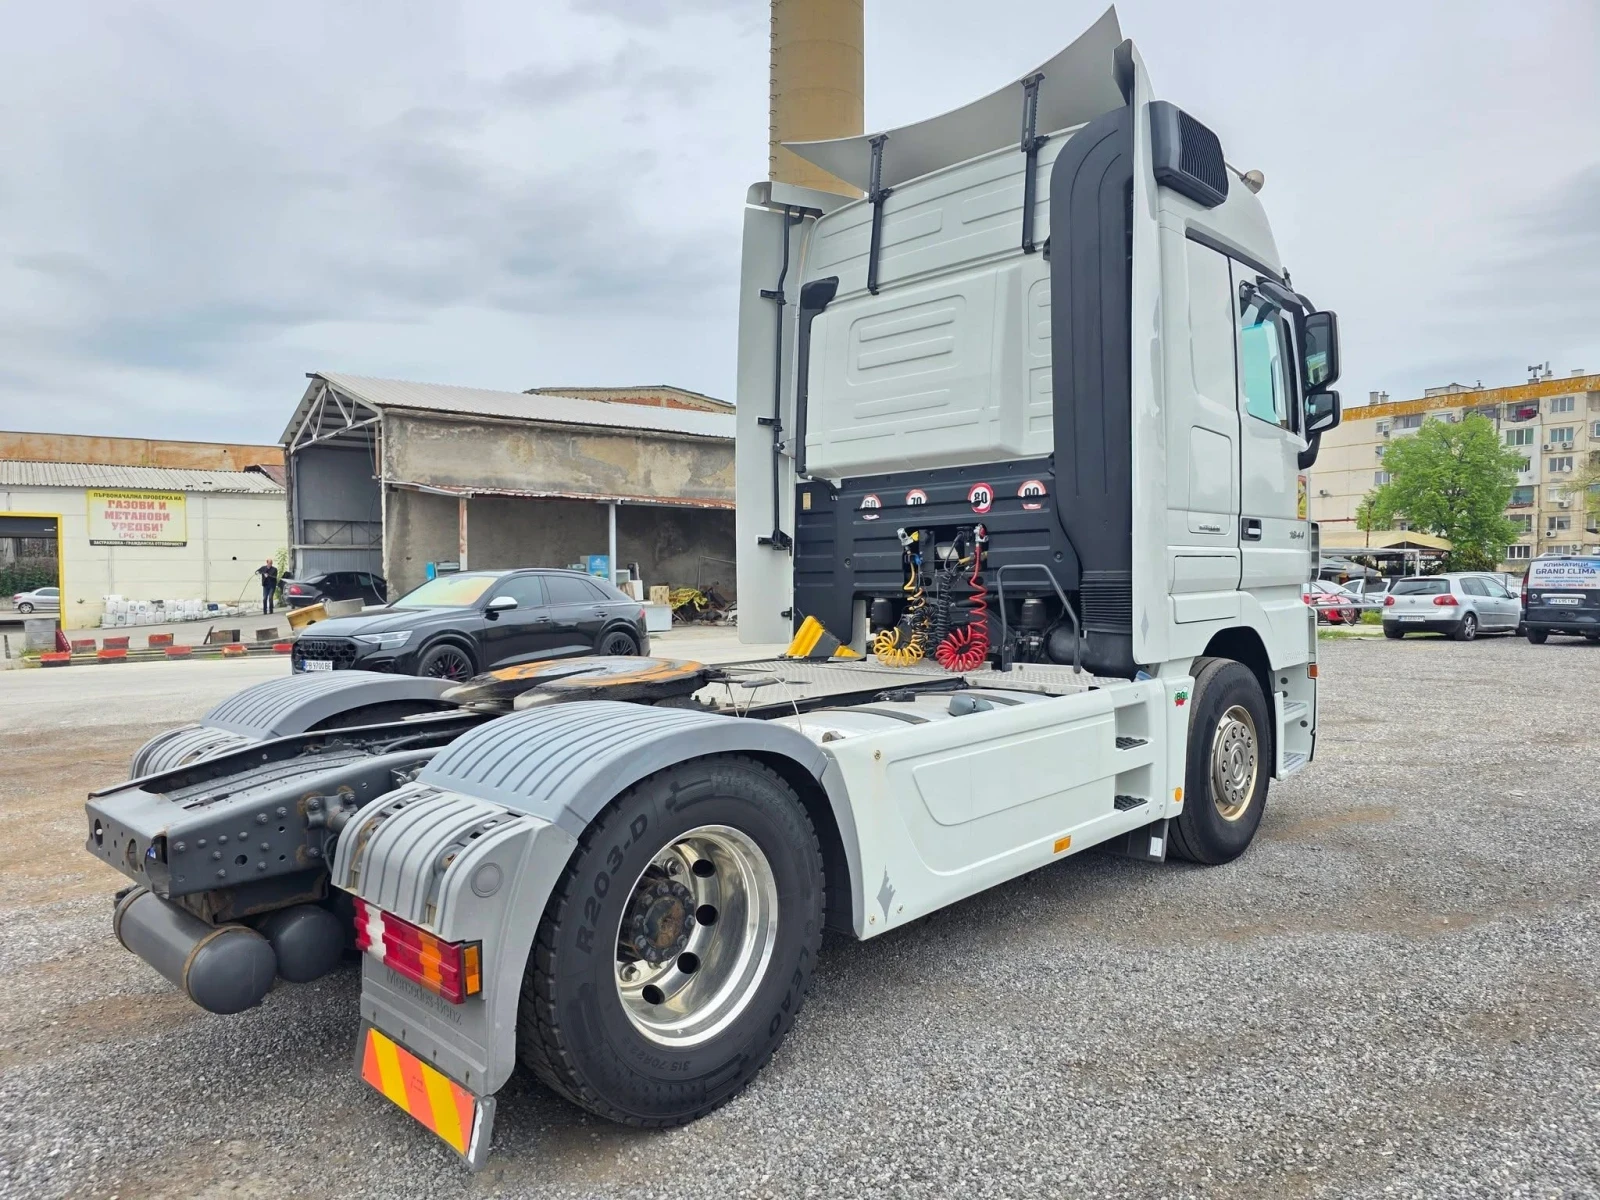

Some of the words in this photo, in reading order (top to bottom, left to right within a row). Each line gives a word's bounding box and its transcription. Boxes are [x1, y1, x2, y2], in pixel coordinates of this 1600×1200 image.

[974, 491, 987, 503] 80
[107, 500, 155, 510] ГАЗОВИ
[159, 501, 166, 510] И
[104, 511, 170, 521] МЕТАНОВИ
[111, 522, 163, 532] УРЕДБИ!
[575, 813, 648, 954] R203-D
[386, 968, 462, 1023] Mercedes-Benz
